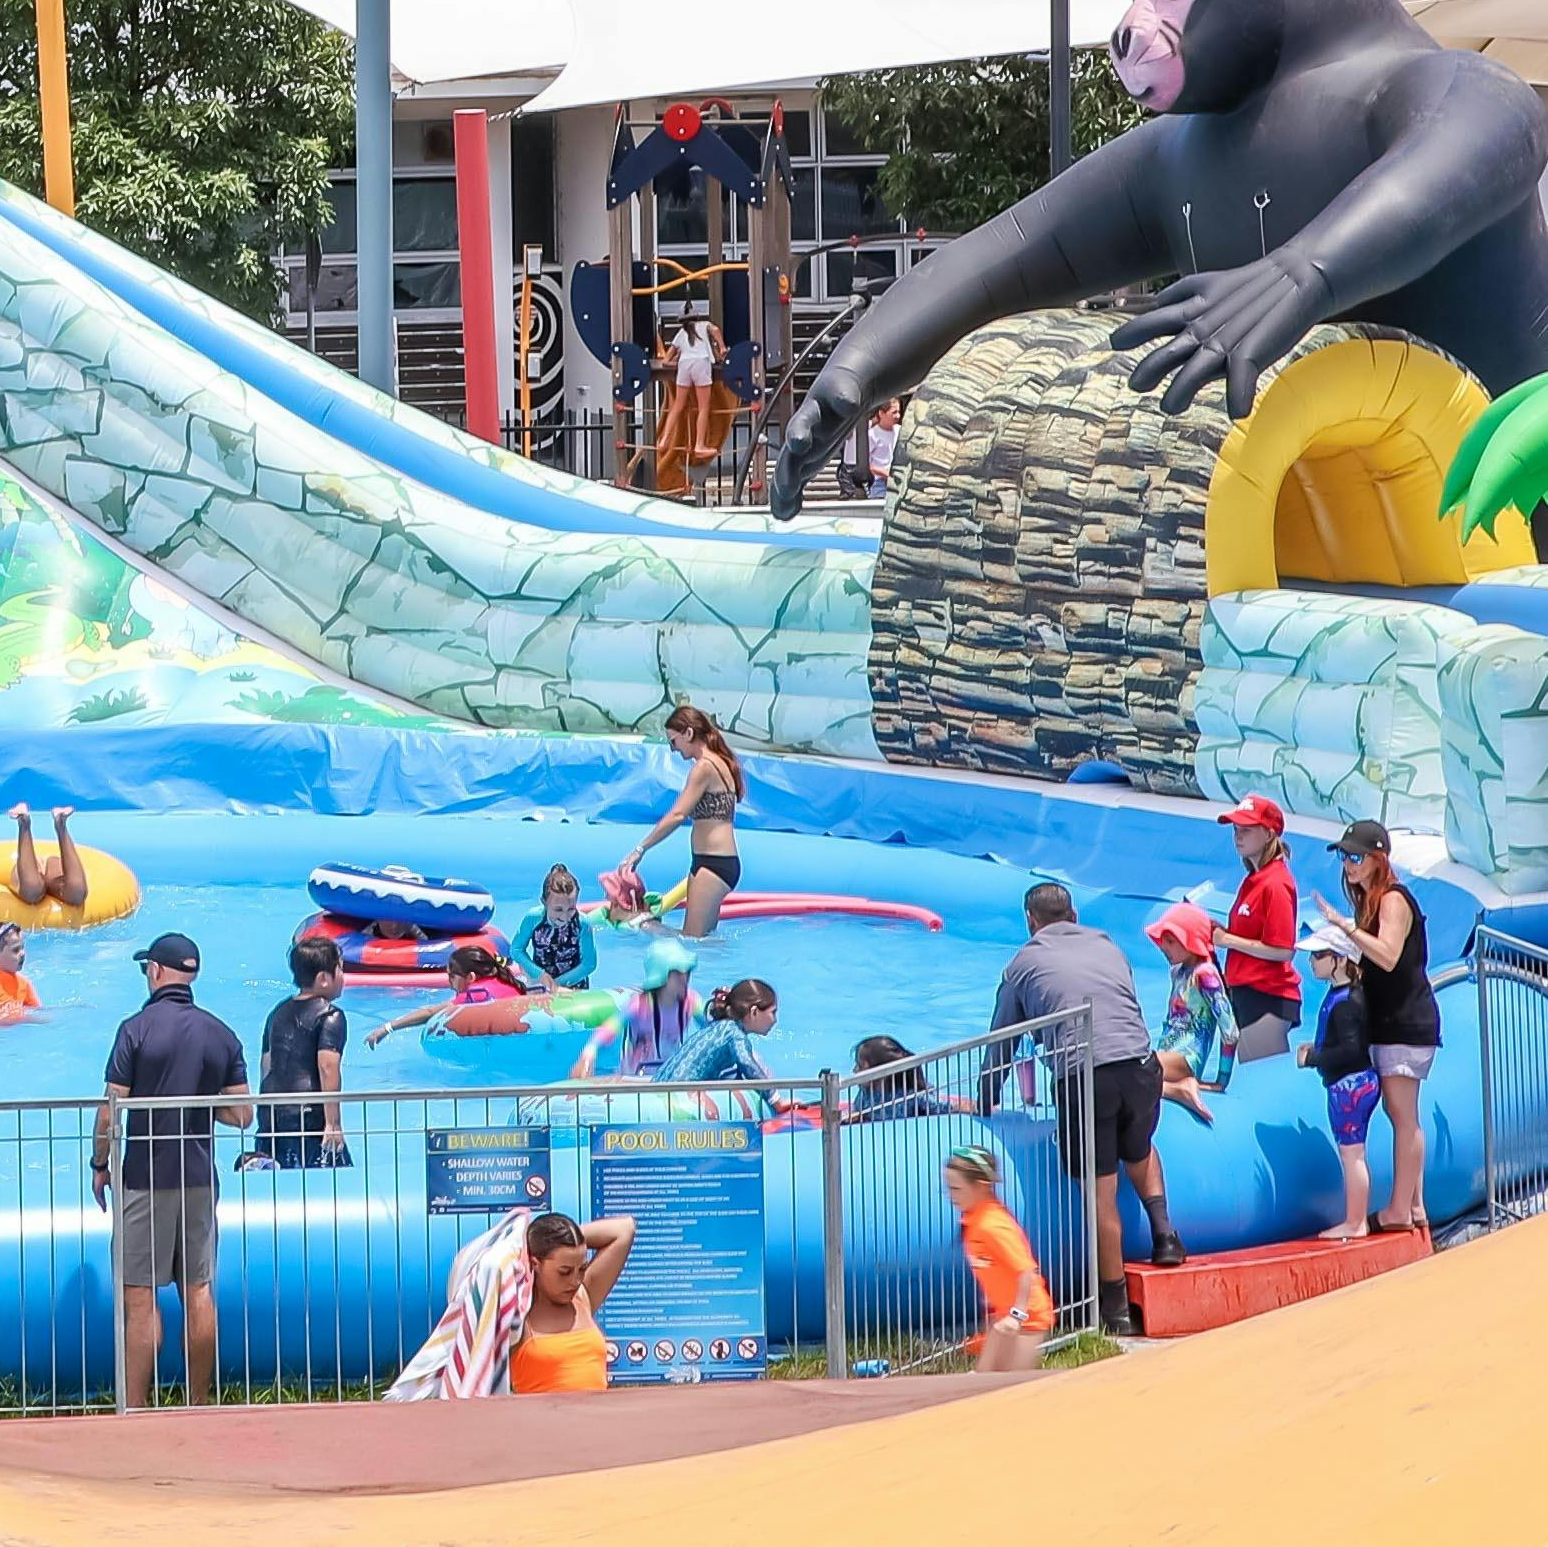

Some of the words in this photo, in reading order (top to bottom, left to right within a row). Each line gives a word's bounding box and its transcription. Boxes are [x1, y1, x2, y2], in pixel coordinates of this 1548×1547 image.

[447, 1132, 529, 1150] BEWARE!
[606, 1131, 668, 1150] POOL
[676, 1129, 748, 1149] RULES
[447, 1157, 495, 1169] SHALLOW
[496, 1156, 530, 1167] WATER
[456, 1172, 488, 1183] DEPTH
[489, 1171, 523, 1181] VARIES
